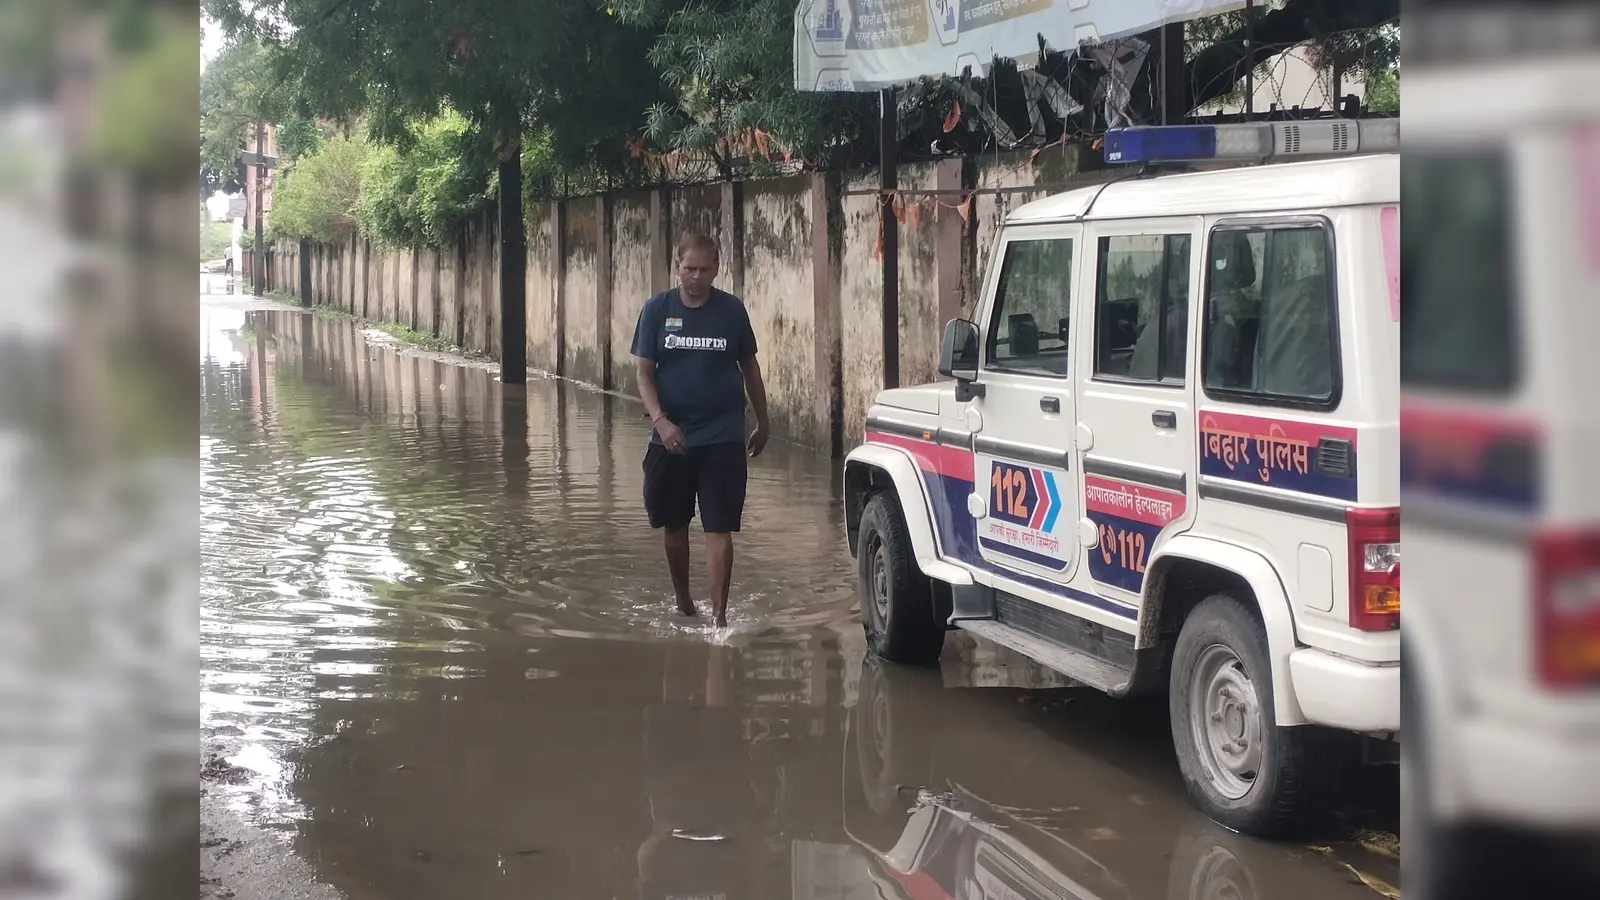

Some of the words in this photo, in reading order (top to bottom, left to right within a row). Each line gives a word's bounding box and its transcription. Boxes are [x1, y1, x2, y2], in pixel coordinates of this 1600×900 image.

[677, 337, 724, 348] MOBIFIX
[1202, 415, 1251, 471] बिहार
[1254, 423, 1310, 482] पुलिस
[992, 466, 1028, 518] 112
[1086, 484, 1133, 510] आपातकालीन
[1135, 488, 1173, 520] हेल्पलाइन
[1118, 530, 1145, 574] 112
